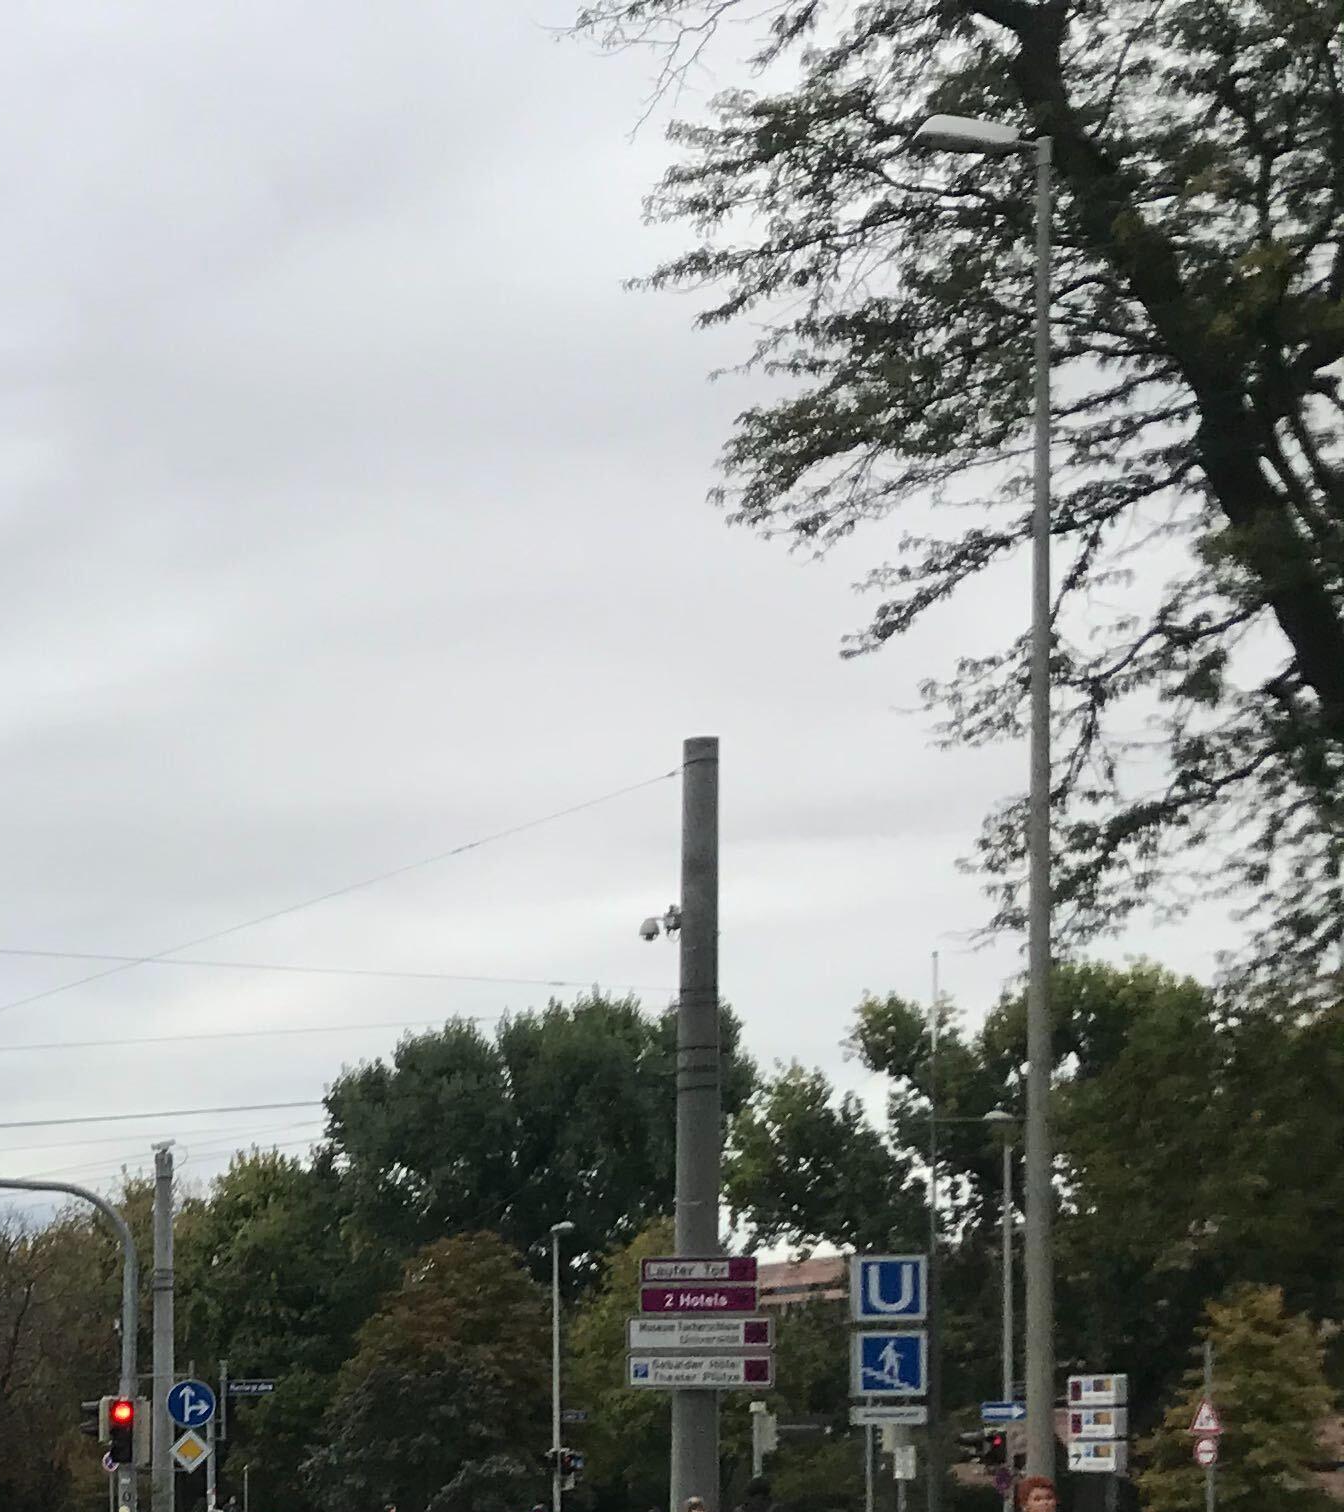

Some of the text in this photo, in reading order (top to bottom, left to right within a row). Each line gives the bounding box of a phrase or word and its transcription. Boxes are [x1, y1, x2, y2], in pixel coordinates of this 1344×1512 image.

[664, 1293, 728, 1307] 2 Hotels
[868, 1264, 912, 1312] U
